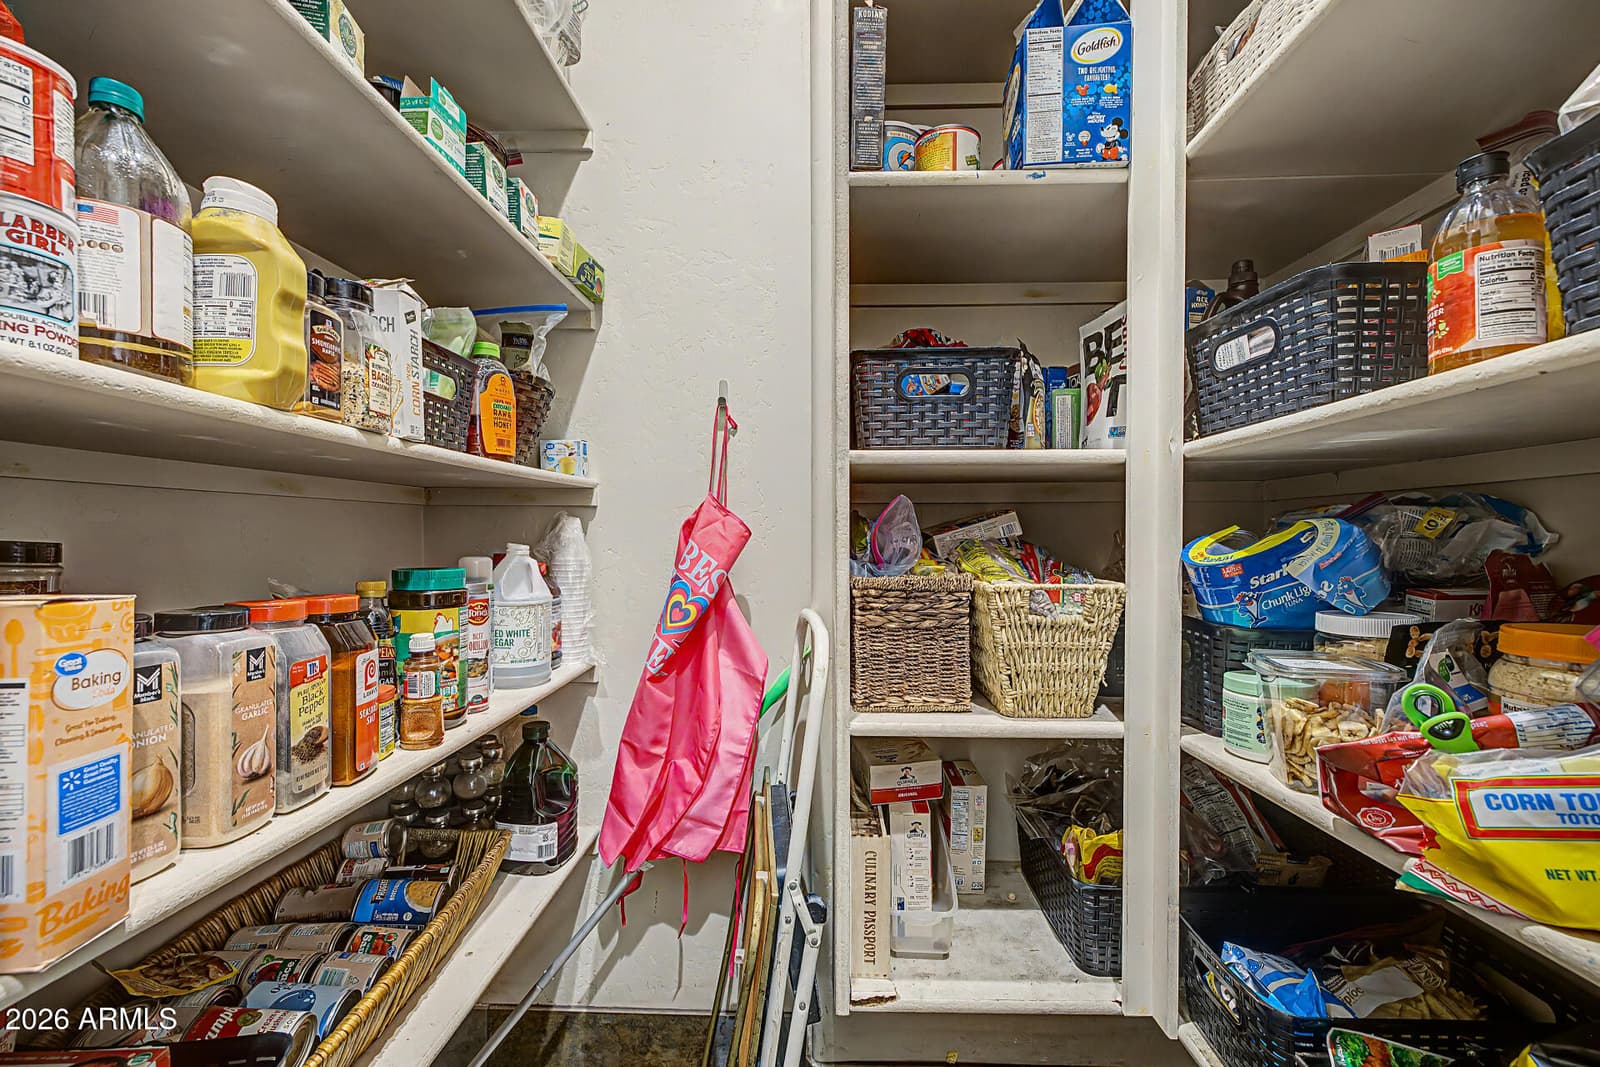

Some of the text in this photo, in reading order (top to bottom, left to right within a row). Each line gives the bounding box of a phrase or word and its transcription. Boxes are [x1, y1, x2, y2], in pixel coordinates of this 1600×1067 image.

[858, 10, 884, 19] KODIAK
[1077, 35, 1118, 57] Goldfish
[6, 228, 62, 257] GIRL
[1479, 250, 1535, 263] Nutrition Facts
[1480, 271, 1536, 285] Calories 0
[412, 381, 421, 417] CORN
[494, 421, 512, 430] HONEY
[1262, 591, 1292, 610] Chunk
[1284, 598, 1303, 609] TUNA
[494, 629, 531, 638] ED WHITE
[494, 638, 515, 647] EGAR
[58, 657, 83, 669] Great
[71, 670, 122, 692] Baking
[302, 688, 324, 706] Black
[235, 699, 273, 716] GRANULATED
[241, 708, 269, 721] GARLIC
[298, 696, 326, 717] Pepper
[1484, 792, 1600, 811] CORN TO
[1545, 868, 1600, 882] NET WT.
[34, 873, 130, 938] Baking
[864, 850, 878, 966] CULINARY PASSPORT
